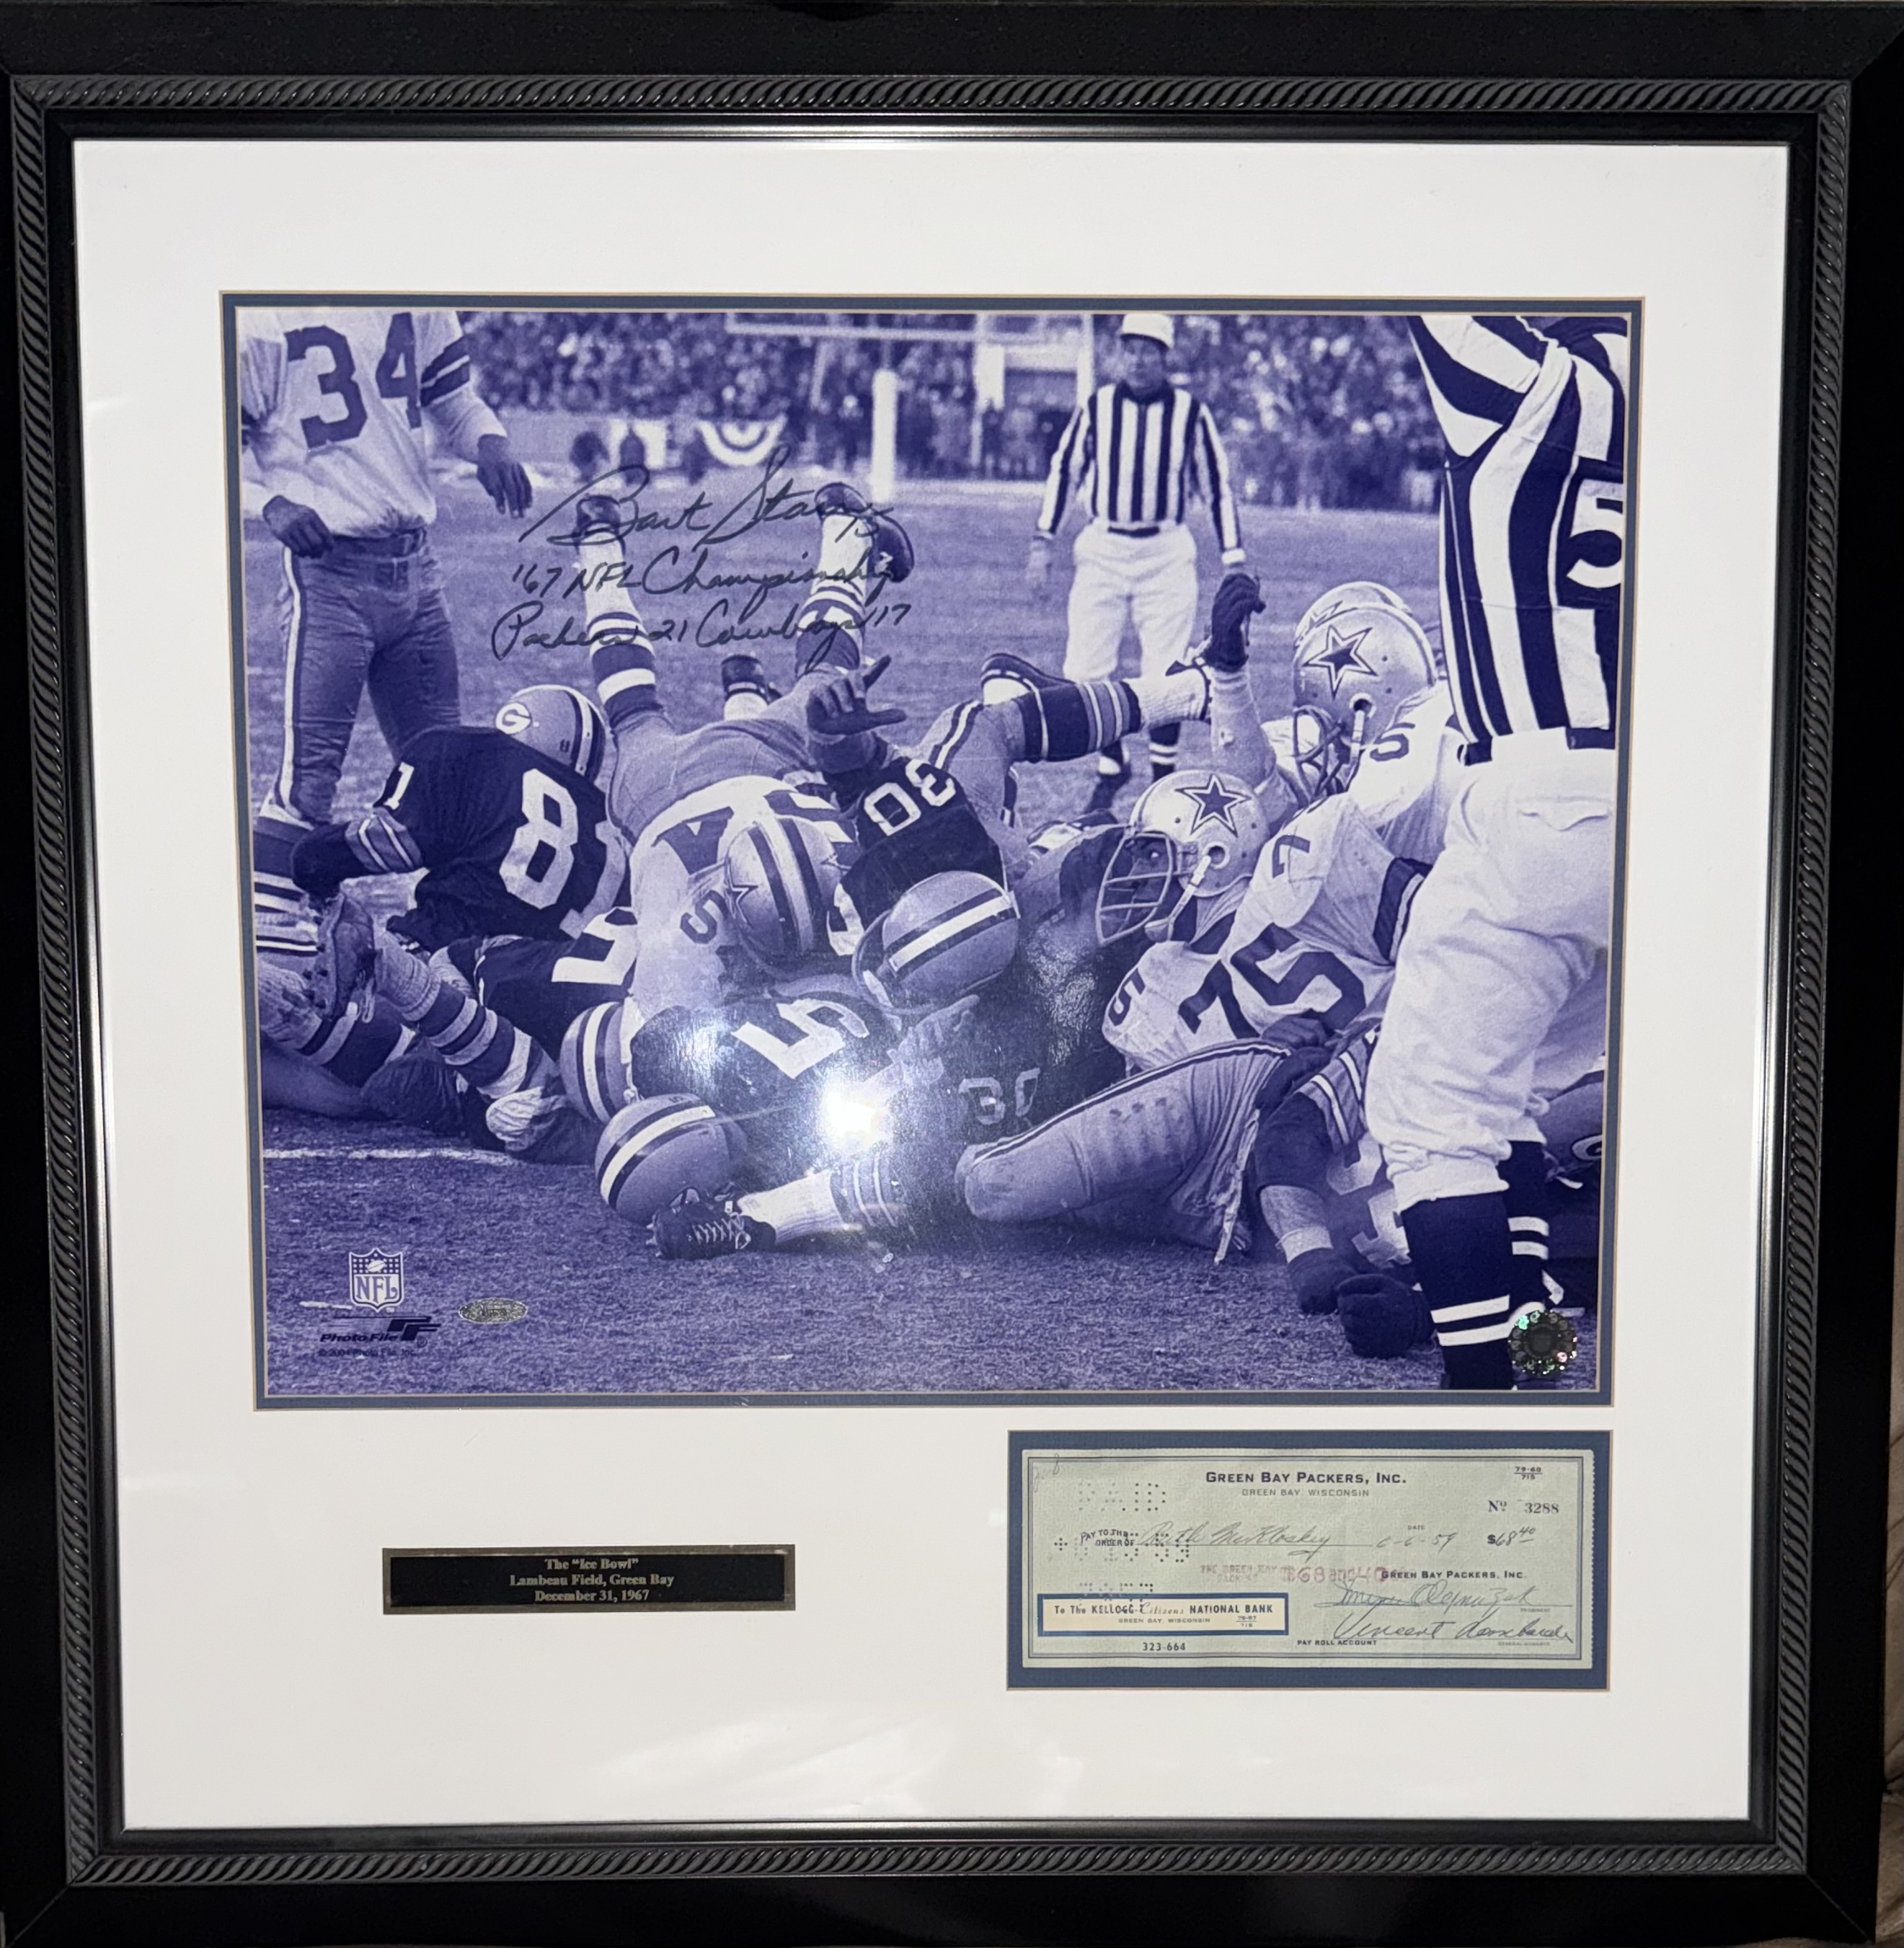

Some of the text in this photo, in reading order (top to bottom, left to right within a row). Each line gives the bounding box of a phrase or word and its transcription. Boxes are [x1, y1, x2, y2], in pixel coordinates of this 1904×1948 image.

[284, 311, 422, 448] 34
[519, 464, 712, 546] Bart
[563, 562, 643, 598] NFL
[650, 621, 686, 642] 21
[355, 1275, 397, 1303] NFL
[1205, 1471, 1407, 1485] GREEN BAY PACKERS, INC.
[1523, 1502, 1559, 1514] 3288
[1080, 1531, 1096, 1546] PAY
[545, 1559, 570, 1570] The
[509, 1574, 676, 1587] Lambeau Field, Green Bay
[534, 1589, 650, 1603] December 31, 1967
[1055, 1605, 1066, 1614] To
[1070, 1605, 1086, 1614] The
[1190, 1605, 1240, 1614] NATIONAL
[1245, 1604, 1273, 1613] BANK
